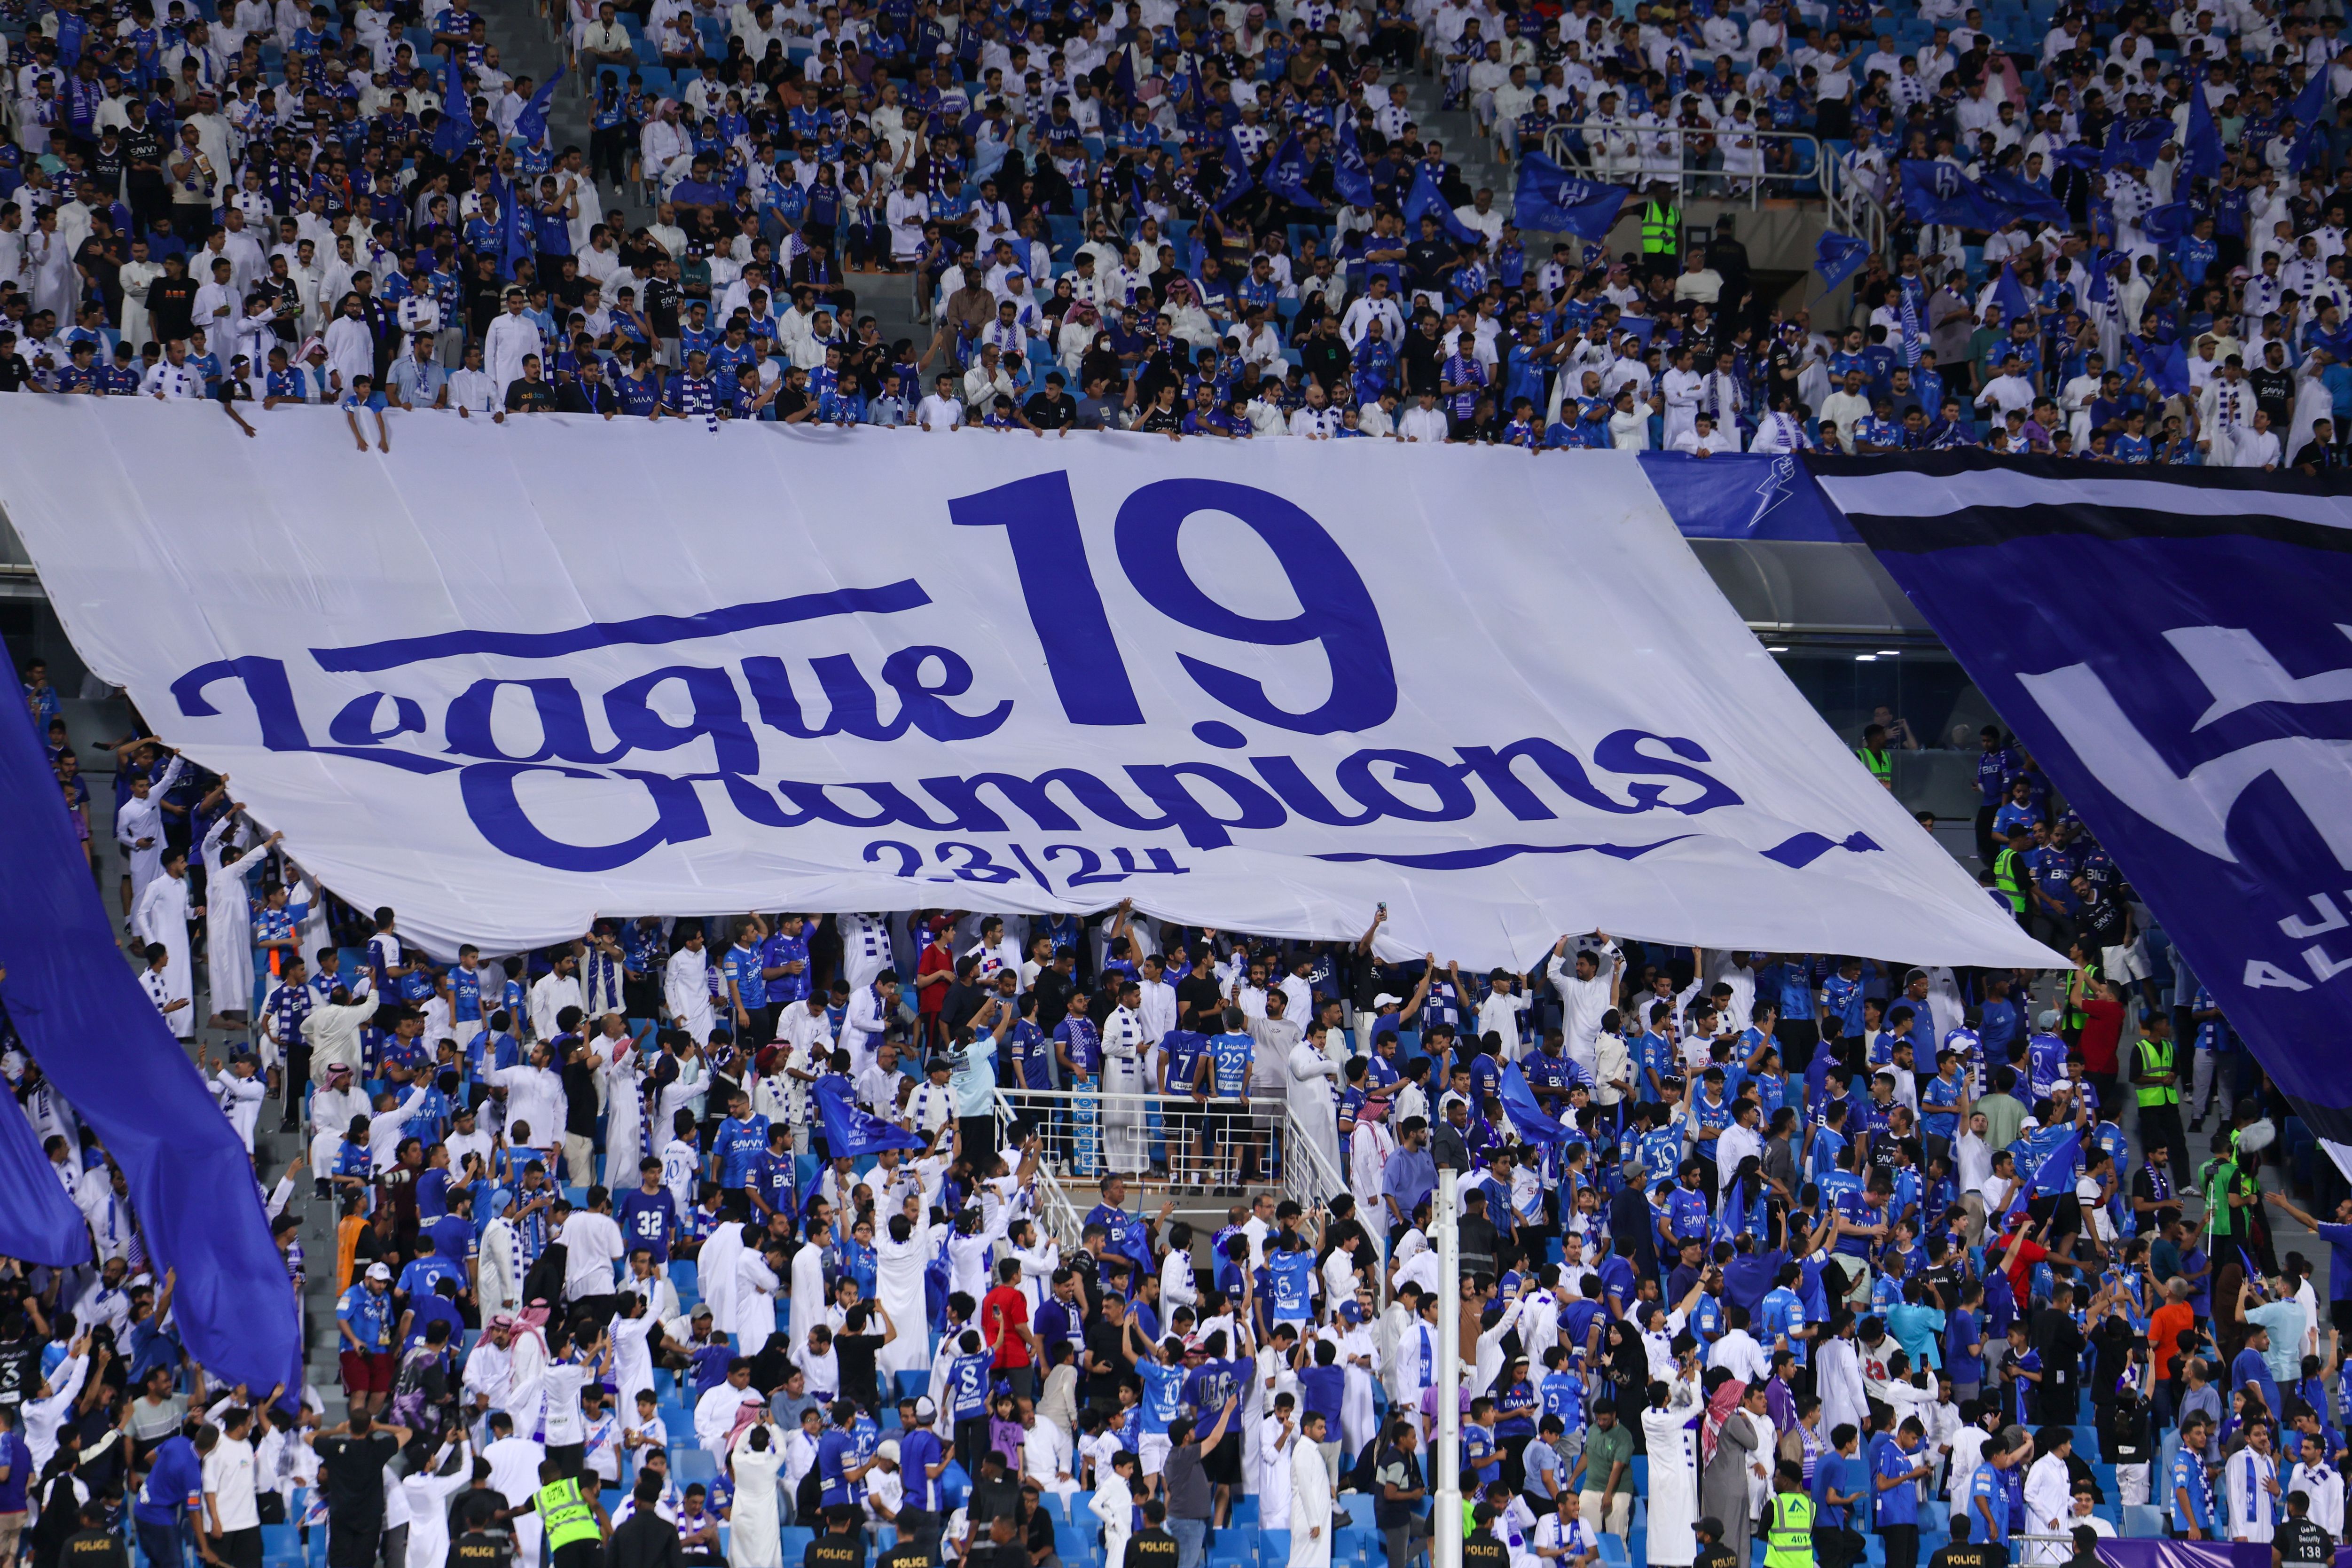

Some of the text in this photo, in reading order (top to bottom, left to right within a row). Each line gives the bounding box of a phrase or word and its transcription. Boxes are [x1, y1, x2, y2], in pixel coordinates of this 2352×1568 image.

[130, 146, 158, 156] SAVVY
[1877, 361, 1886, 375] 9
[947, 469, 1399, 735] 19
[170, 644, 1014, 775] League
[459, 720, 1744, 871] Champions
[1177, 1058, 1191, 1080] 7
[1216, 1056, 1243, 1077] 22
[2031, 1051, 2043, 1071] 9
[731, 1139, 764, 1150] SAVVY
[1078, 1138, 1095, 1171] GOLD
[1652, 1142, 1678, 1169] 10
[664, 1159, 679, 1179] 10
[637, 1210, 662, 1236] 32
[6, 1360, 21, 1388] 3
[962, 1364, 978, 1394] 8
[1164, 1380, 1180, 1406] 10
[1548, 1393, 1560, 1414] 9
[856, 1433, 876, 1456] 10
[74, 1539, 111, 1553] POLICE
[1138, 1540, 1175, 1554] POLICE
[1791, 1534, 1809, 1544] 401
[2298, 1534, 2321, 1544] Security
[460, 1545, 496, 1558] POLICE
[816, 1547, 854, 1561] POLICE
[1465, 1544, 1499, 1558] POLICE
[1946, 1554, 1982, 1566] POLICE
[2299, 1545, 2321, 1559] 138
[892, 1556, 928, 1568] POLICE
